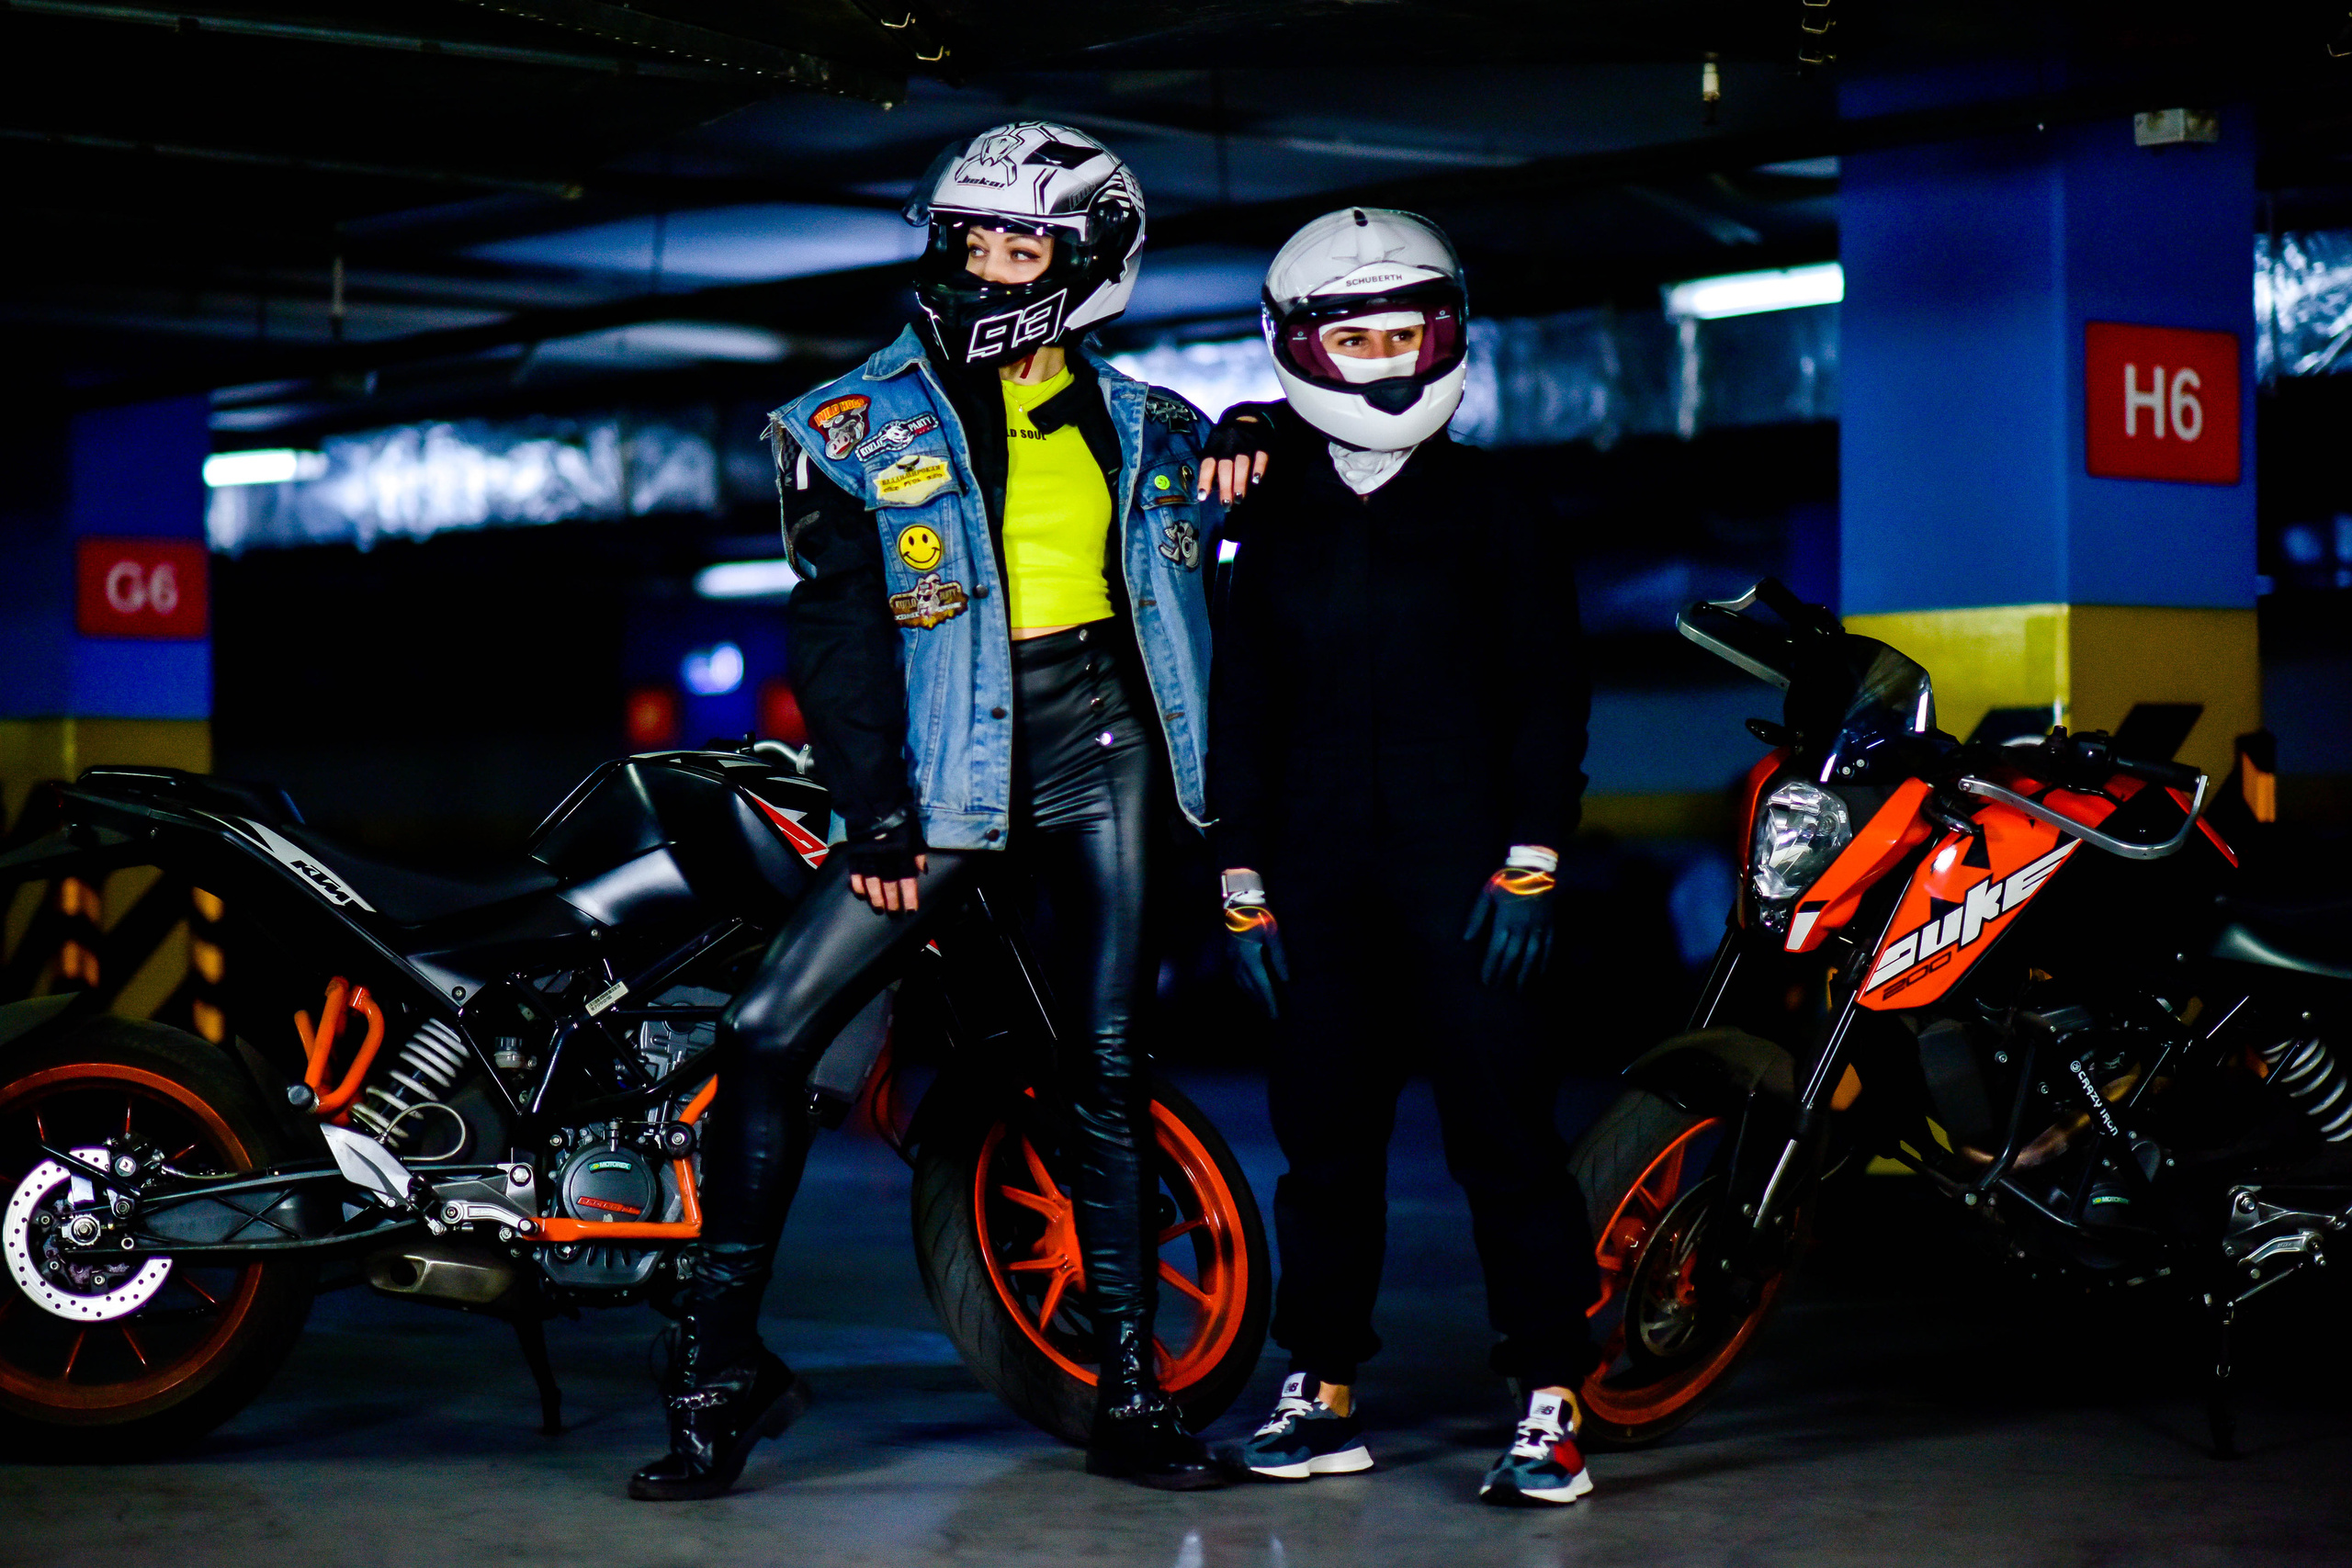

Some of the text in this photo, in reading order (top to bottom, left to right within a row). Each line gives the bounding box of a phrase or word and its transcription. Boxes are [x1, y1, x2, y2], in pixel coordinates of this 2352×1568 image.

[1346, 274, 1403, 287] SCHUBERTH
[814, 404, 840, 426] WILD
[2124, 363, 2202, 442] H6
[907, 416, 933, 432] PARTY
[1020, 429, 1046, 440] SOUL
[105, 560, 178, 615] G6
[289, 860, 351, 903] KTM
[1883, 951, 1952, 1001] 200
[2077, 1070, 2103, 1108] CRAZY
